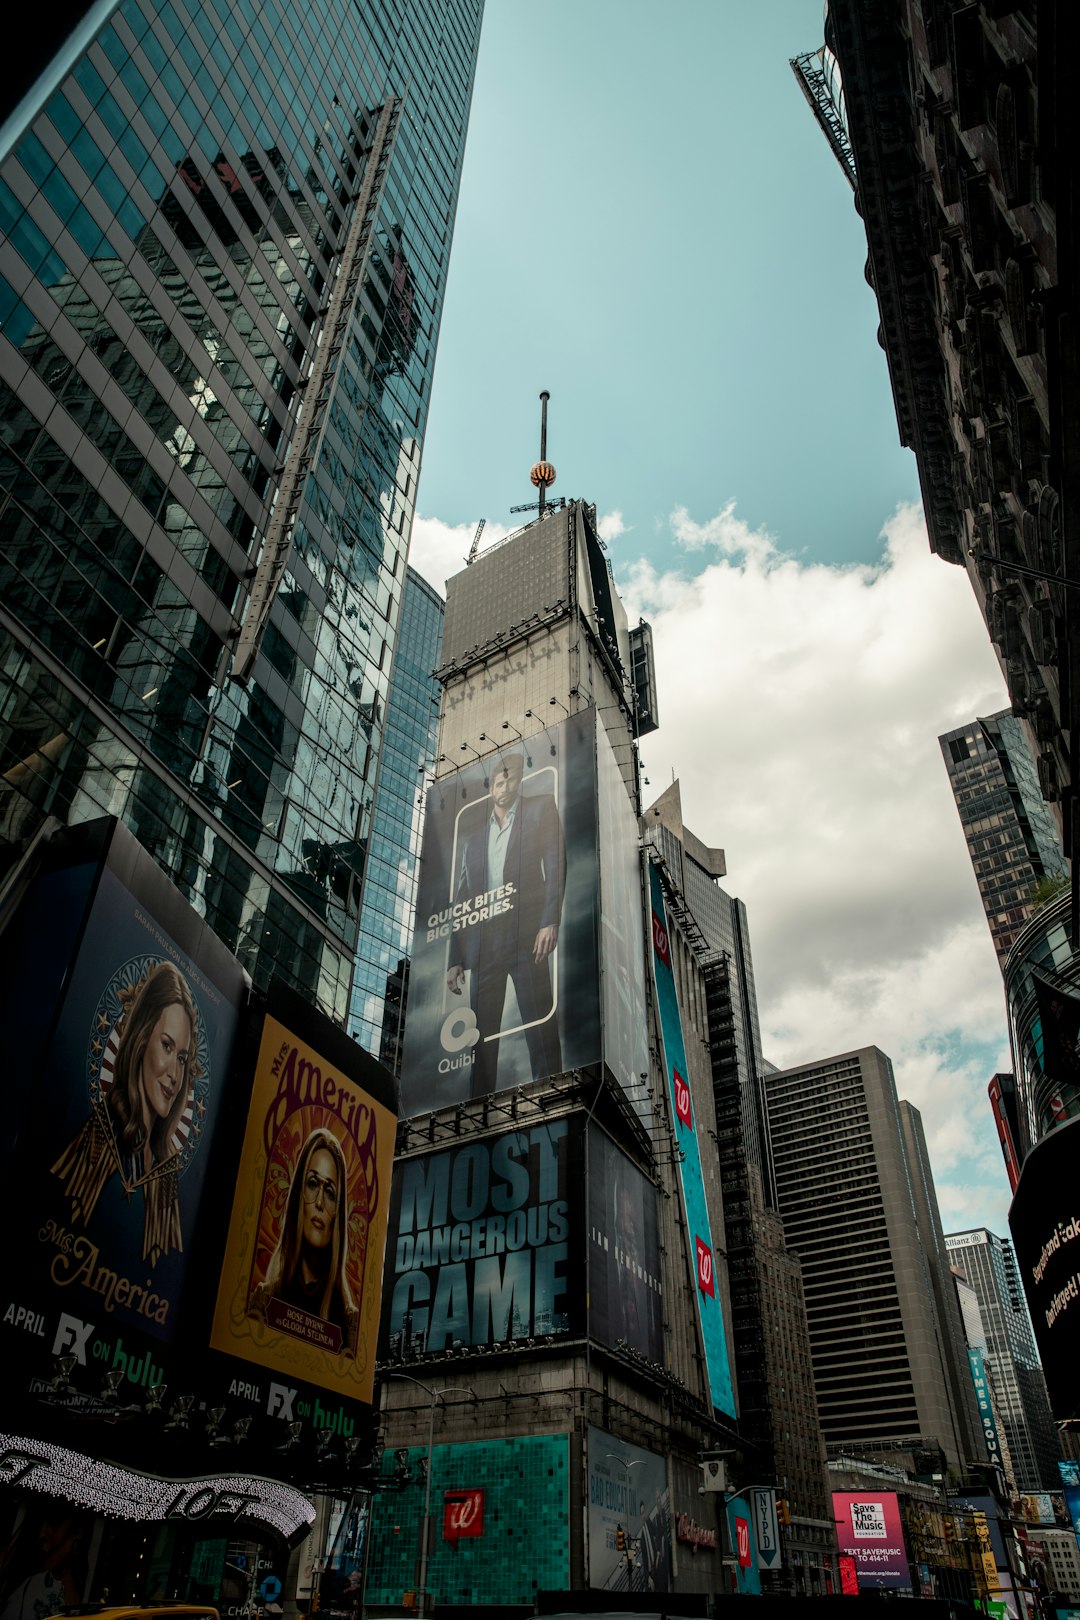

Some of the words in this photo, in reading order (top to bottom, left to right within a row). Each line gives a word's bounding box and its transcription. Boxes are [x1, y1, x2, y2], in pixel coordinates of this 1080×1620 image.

[426, 923, 450, 943] BIG
[452, 899, 514, 932] STORIES.
[427, 898, 472, 928] QUICK
[475, 882, 517, 910] BITES.
[270, 1041, 291, 1079] Mrs.
[438, 1050, 476, 1074] Quibi
[264, 1047, 379, 1222] America
[398, 1119, 569, 1234] MOST
[37, 1219, 75, 1254] Mrs.
[394, 1200, 570, 1274] DANGEROUS
[945, 1237, 970, 1247] Allianz
[50, 1235, 170, 1326] America
[388, 1242, 570, 1354] GAME
[282, 1317, 306, 1336] GLORIA
[286, 1308, 304, 1324] ROSE
[3, 1302, 46, 1338] APRIL
[52, 1311, 96, 1367] FX
[92, 1339, 111, 1362] ON
[112, 1337, 166, 1388] hulu
[970, 1356, 989, 1410] TIMES
[228, 1378, 261, 1403] APRIL
[266, 1381, 298, 1422] FX
[297, 1400, 311, 1418] ON
[312, 1398, 356, 1436] hulu
[166, 1488, 261, 1524] LOFT
[591, 1474, 604, 1507] BAD
[853, 1503, 875, 1512] Save
[760, 1493, 771, 1549] NYPD
[854, 1511, 873, 1521] The
[855, 1520, 883, 1530] Music
